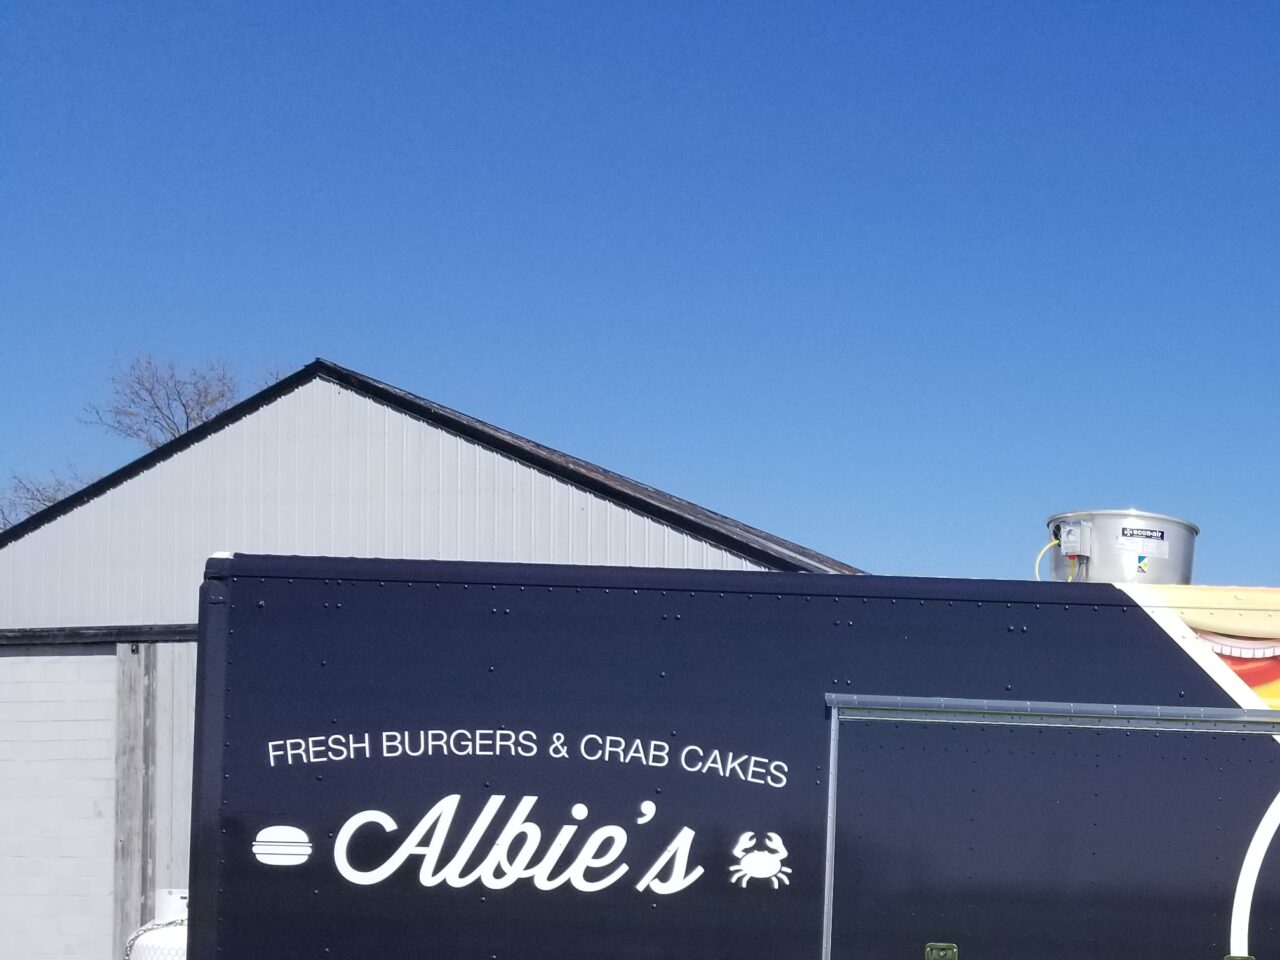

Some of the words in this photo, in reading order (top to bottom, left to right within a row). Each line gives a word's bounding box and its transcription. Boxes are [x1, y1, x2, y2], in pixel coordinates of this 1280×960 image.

[268, 732, 370, 767] FRESH
[382, 729, 538, 757] BURGERS
[548, 732, 569, 759] &
[580, 733, 670, 767] CRAB
[680, 745, 789, 788] CAKES
[333, 794, 705, 895] Albie's
